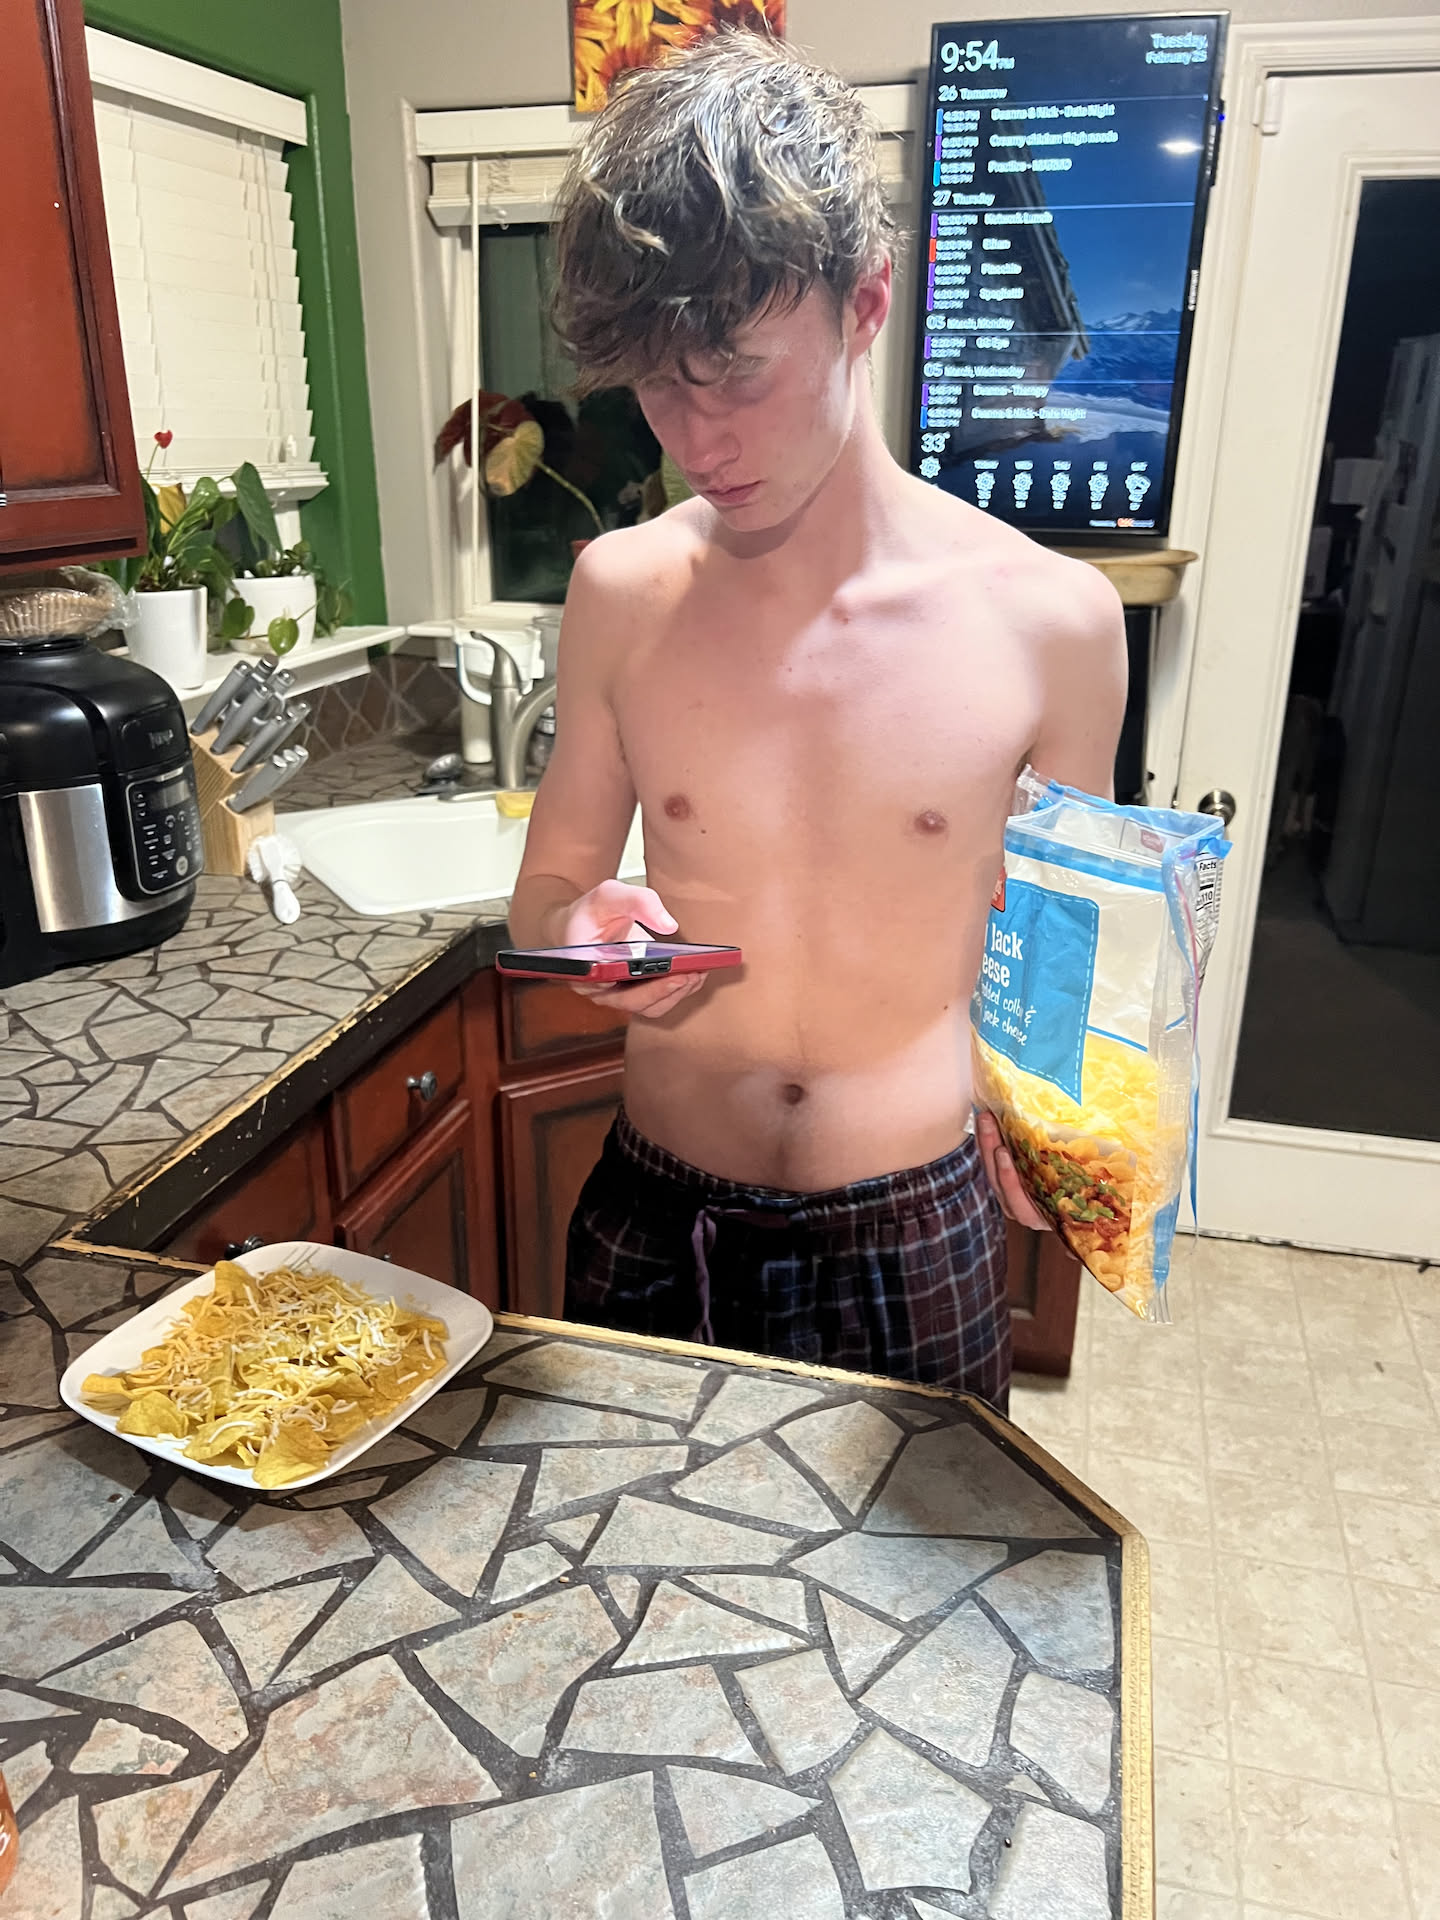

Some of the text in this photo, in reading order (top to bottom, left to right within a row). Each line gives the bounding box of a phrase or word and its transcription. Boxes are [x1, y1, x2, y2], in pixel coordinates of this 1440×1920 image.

[938, 85, 958, 101] 26
[932, 190, 951, 206] 27
[924, 362, 943, 377] 05
[1200, 861, 1217, 871] Facts
